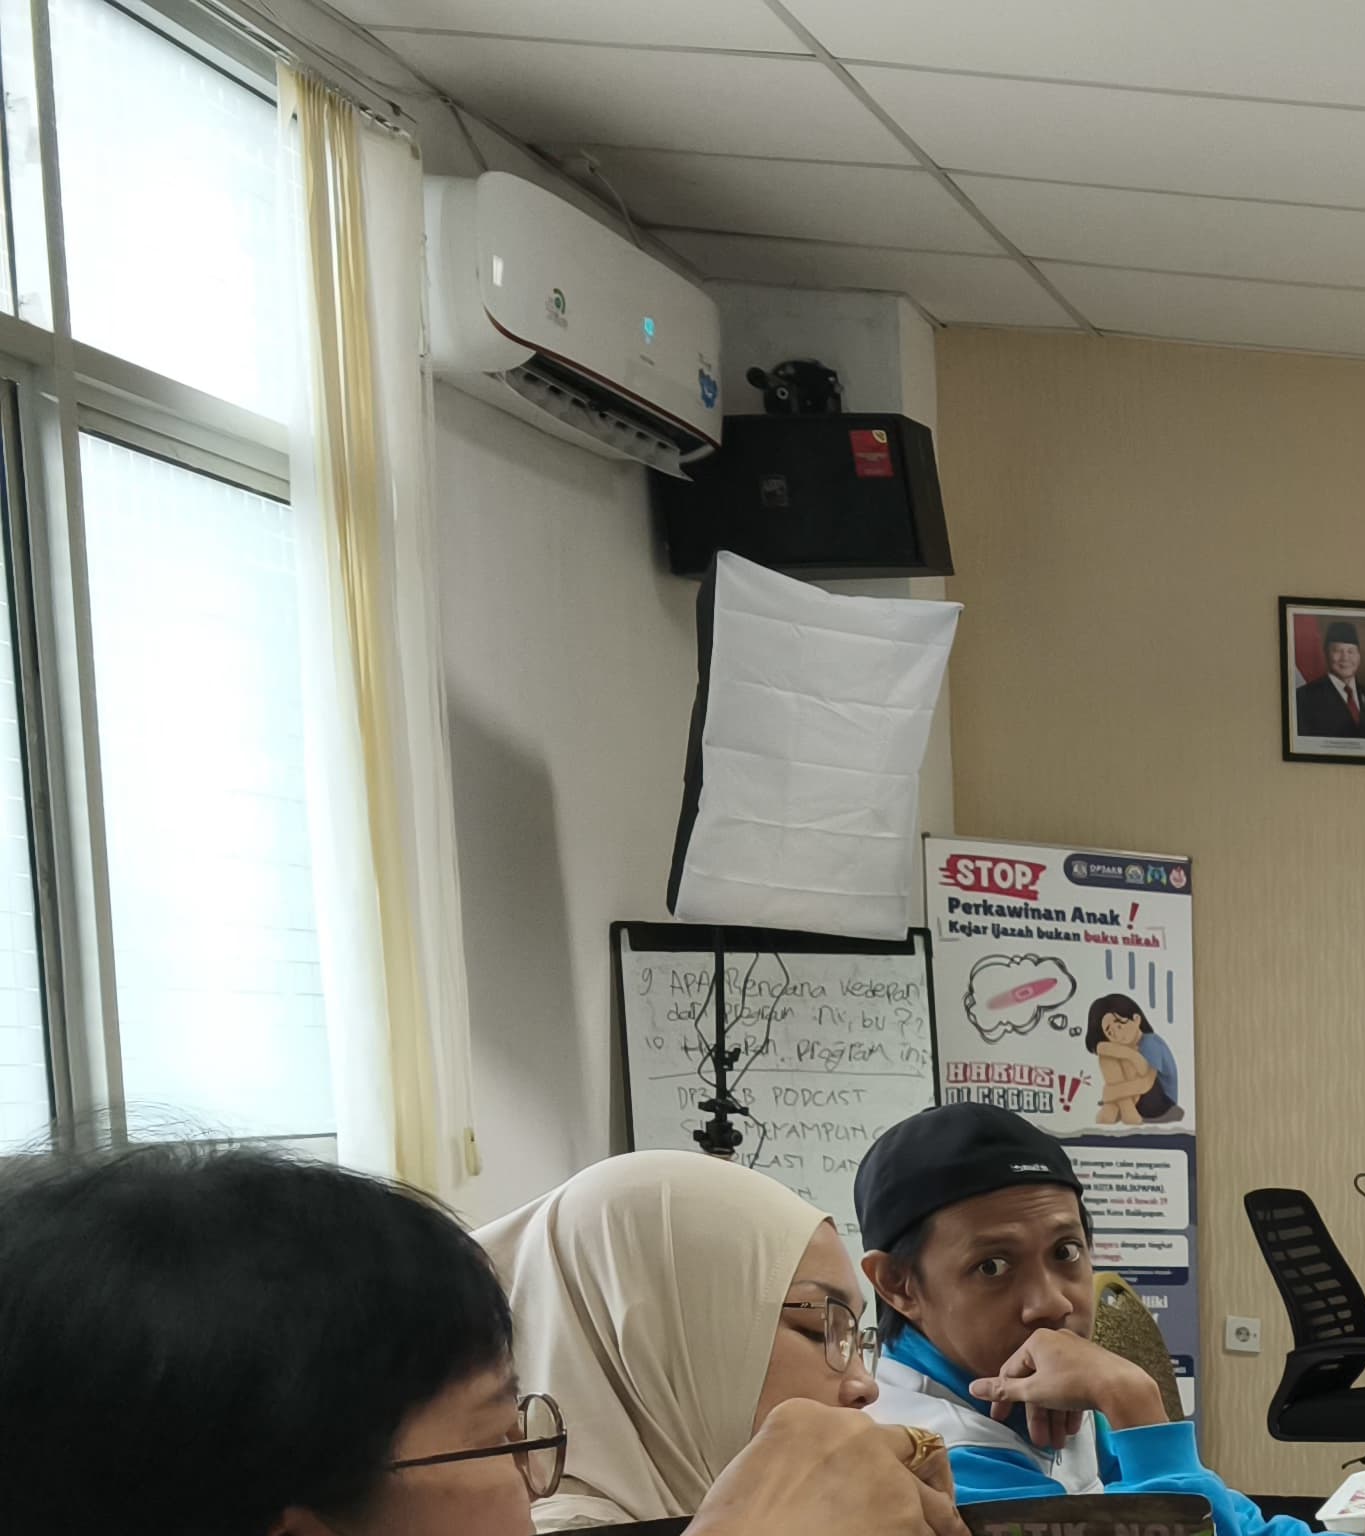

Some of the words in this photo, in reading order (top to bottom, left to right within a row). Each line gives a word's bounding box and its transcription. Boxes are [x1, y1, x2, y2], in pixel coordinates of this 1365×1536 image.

[956, 859, 1032, 890] STOP
[948, 897, 1066, 922] Perkawinan
[1072, 906, 1120, 926] Anak
[949, 920, 988, 937] Kejar
[1037, 926, 1080, 942] bukan
[1084, 930, 1119, 945] buku
[1122, 932, 1160, 948] nikah
[948, 1061, 1053, 1088] HARUS
